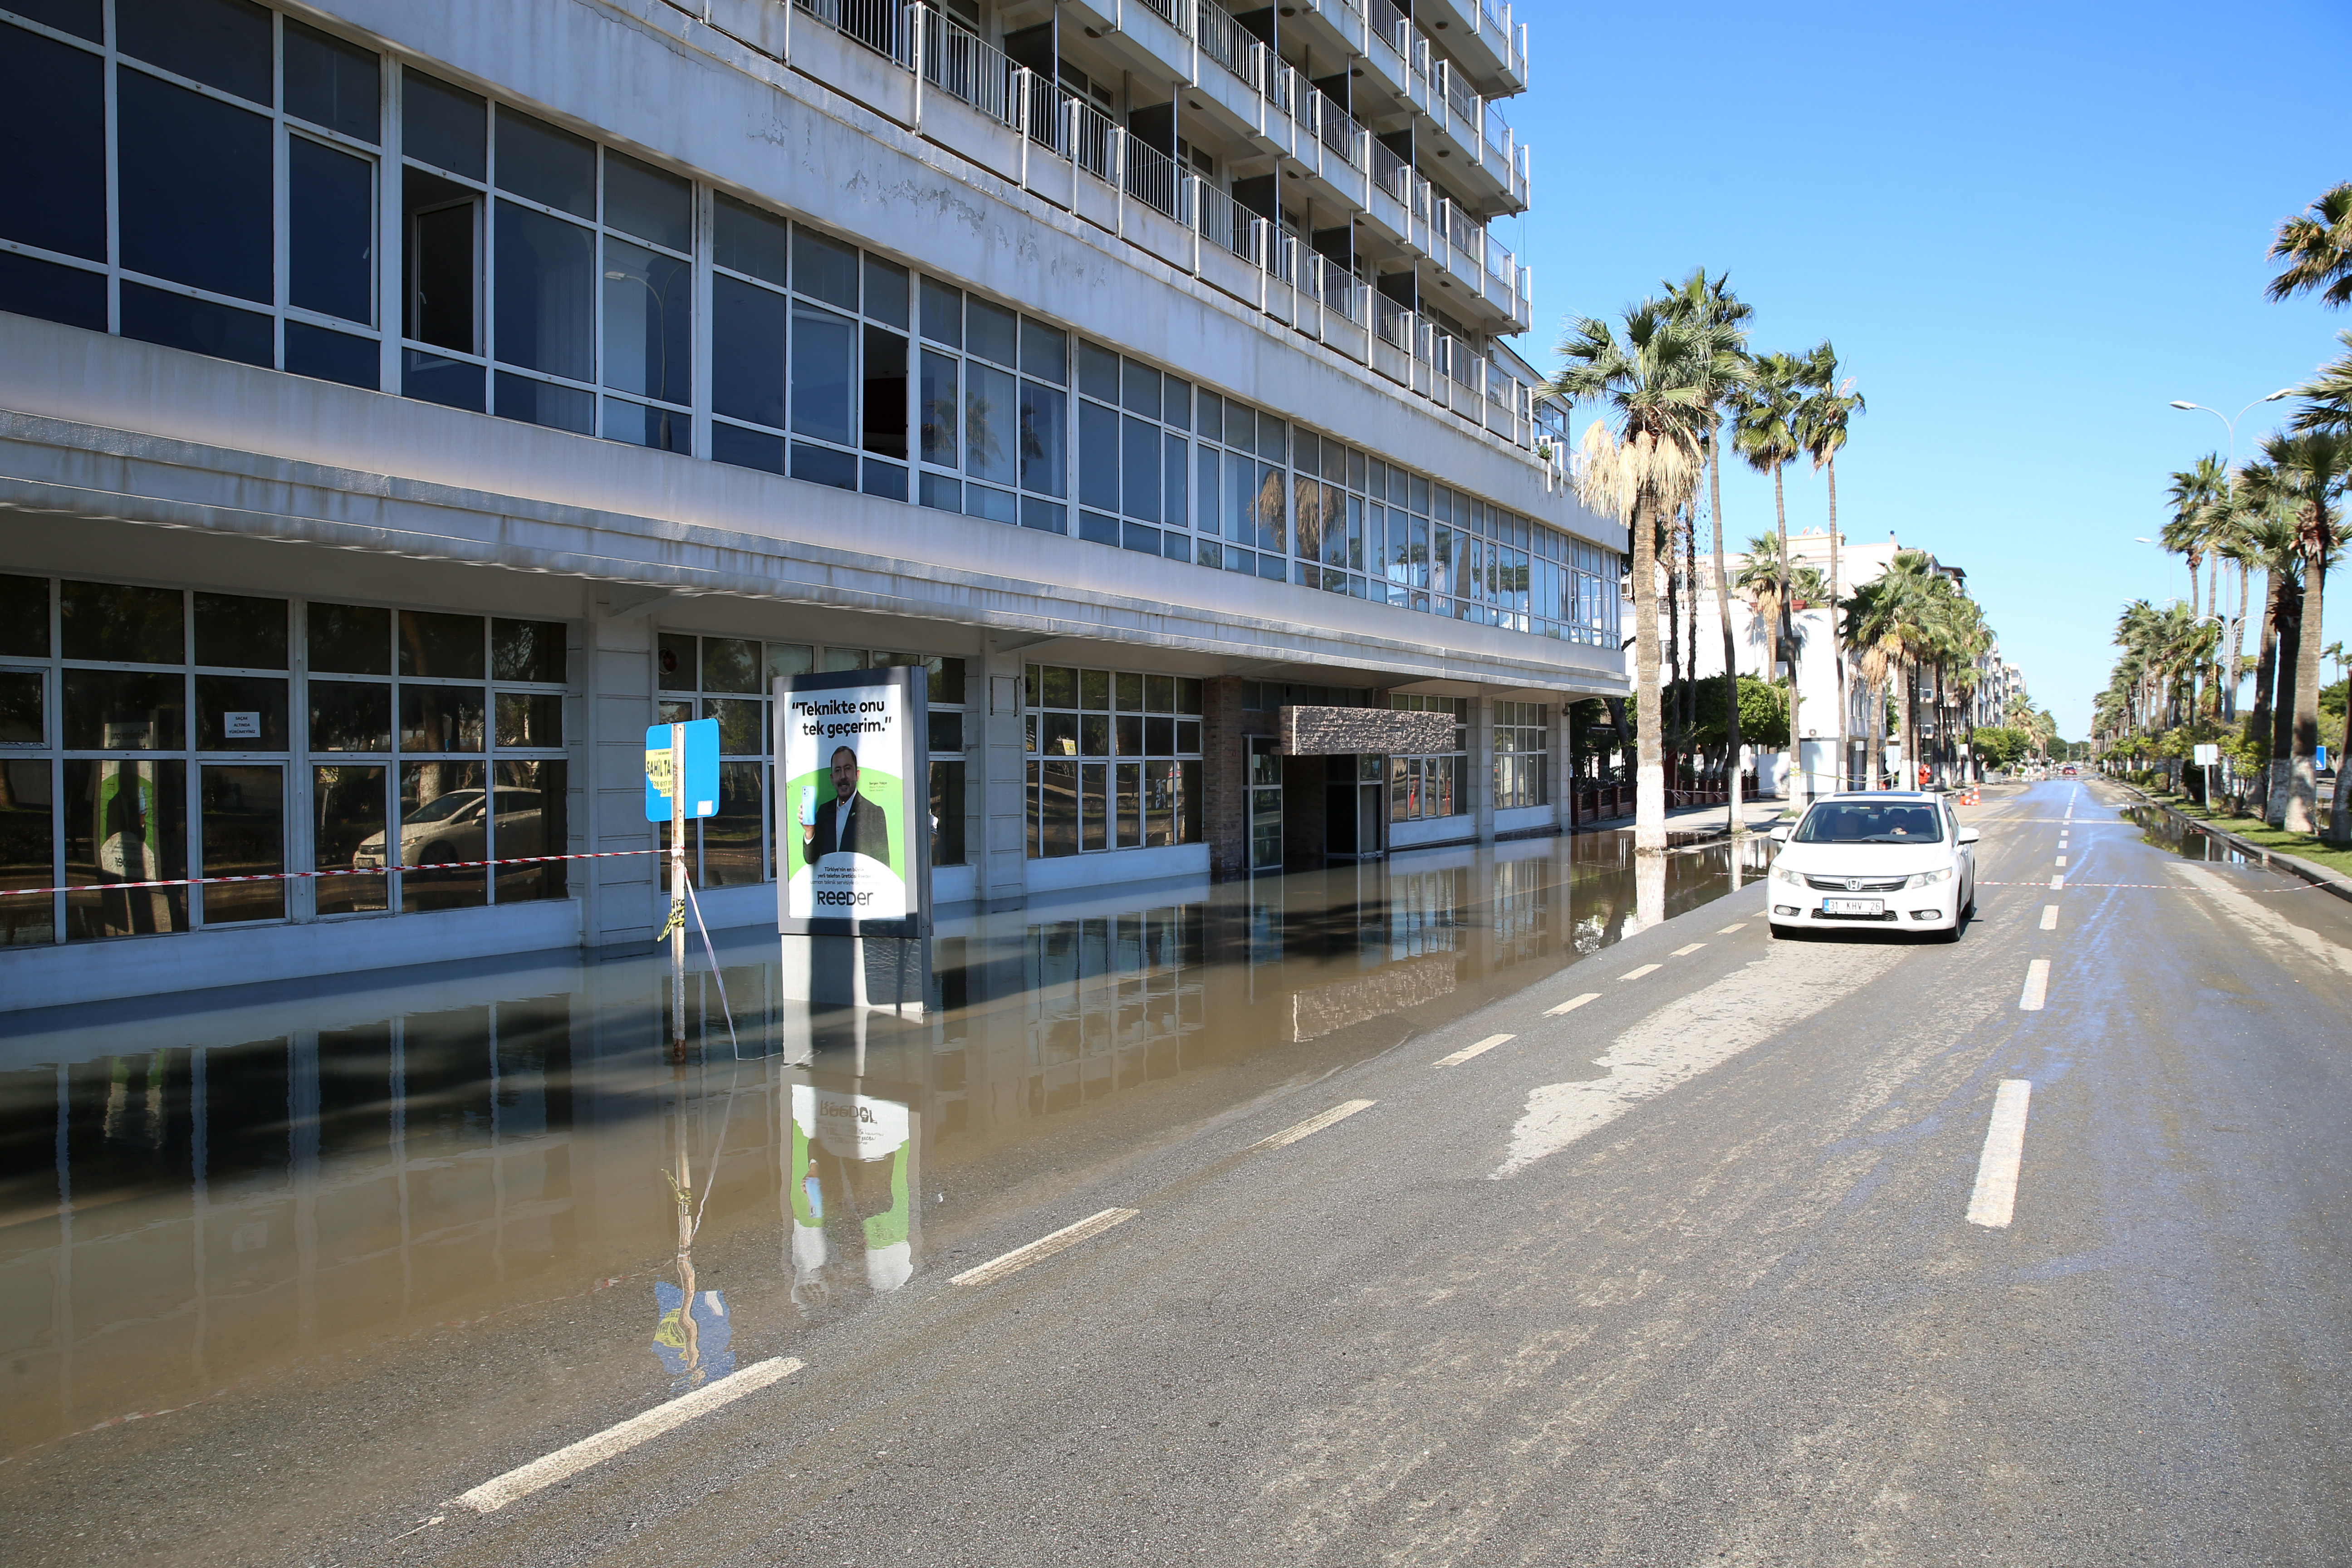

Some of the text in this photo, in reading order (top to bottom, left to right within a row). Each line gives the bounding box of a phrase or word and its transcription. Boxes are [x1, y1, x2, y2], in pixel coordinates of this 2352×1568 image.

[859, 701, 885, 713] onu
[802, 716, 892, 739] tek geçerim."
[1830, 901, 1838, 910] 31
[1846, 902, 1862, 910] KHV
[1870, 902, 1881, 911] 26
